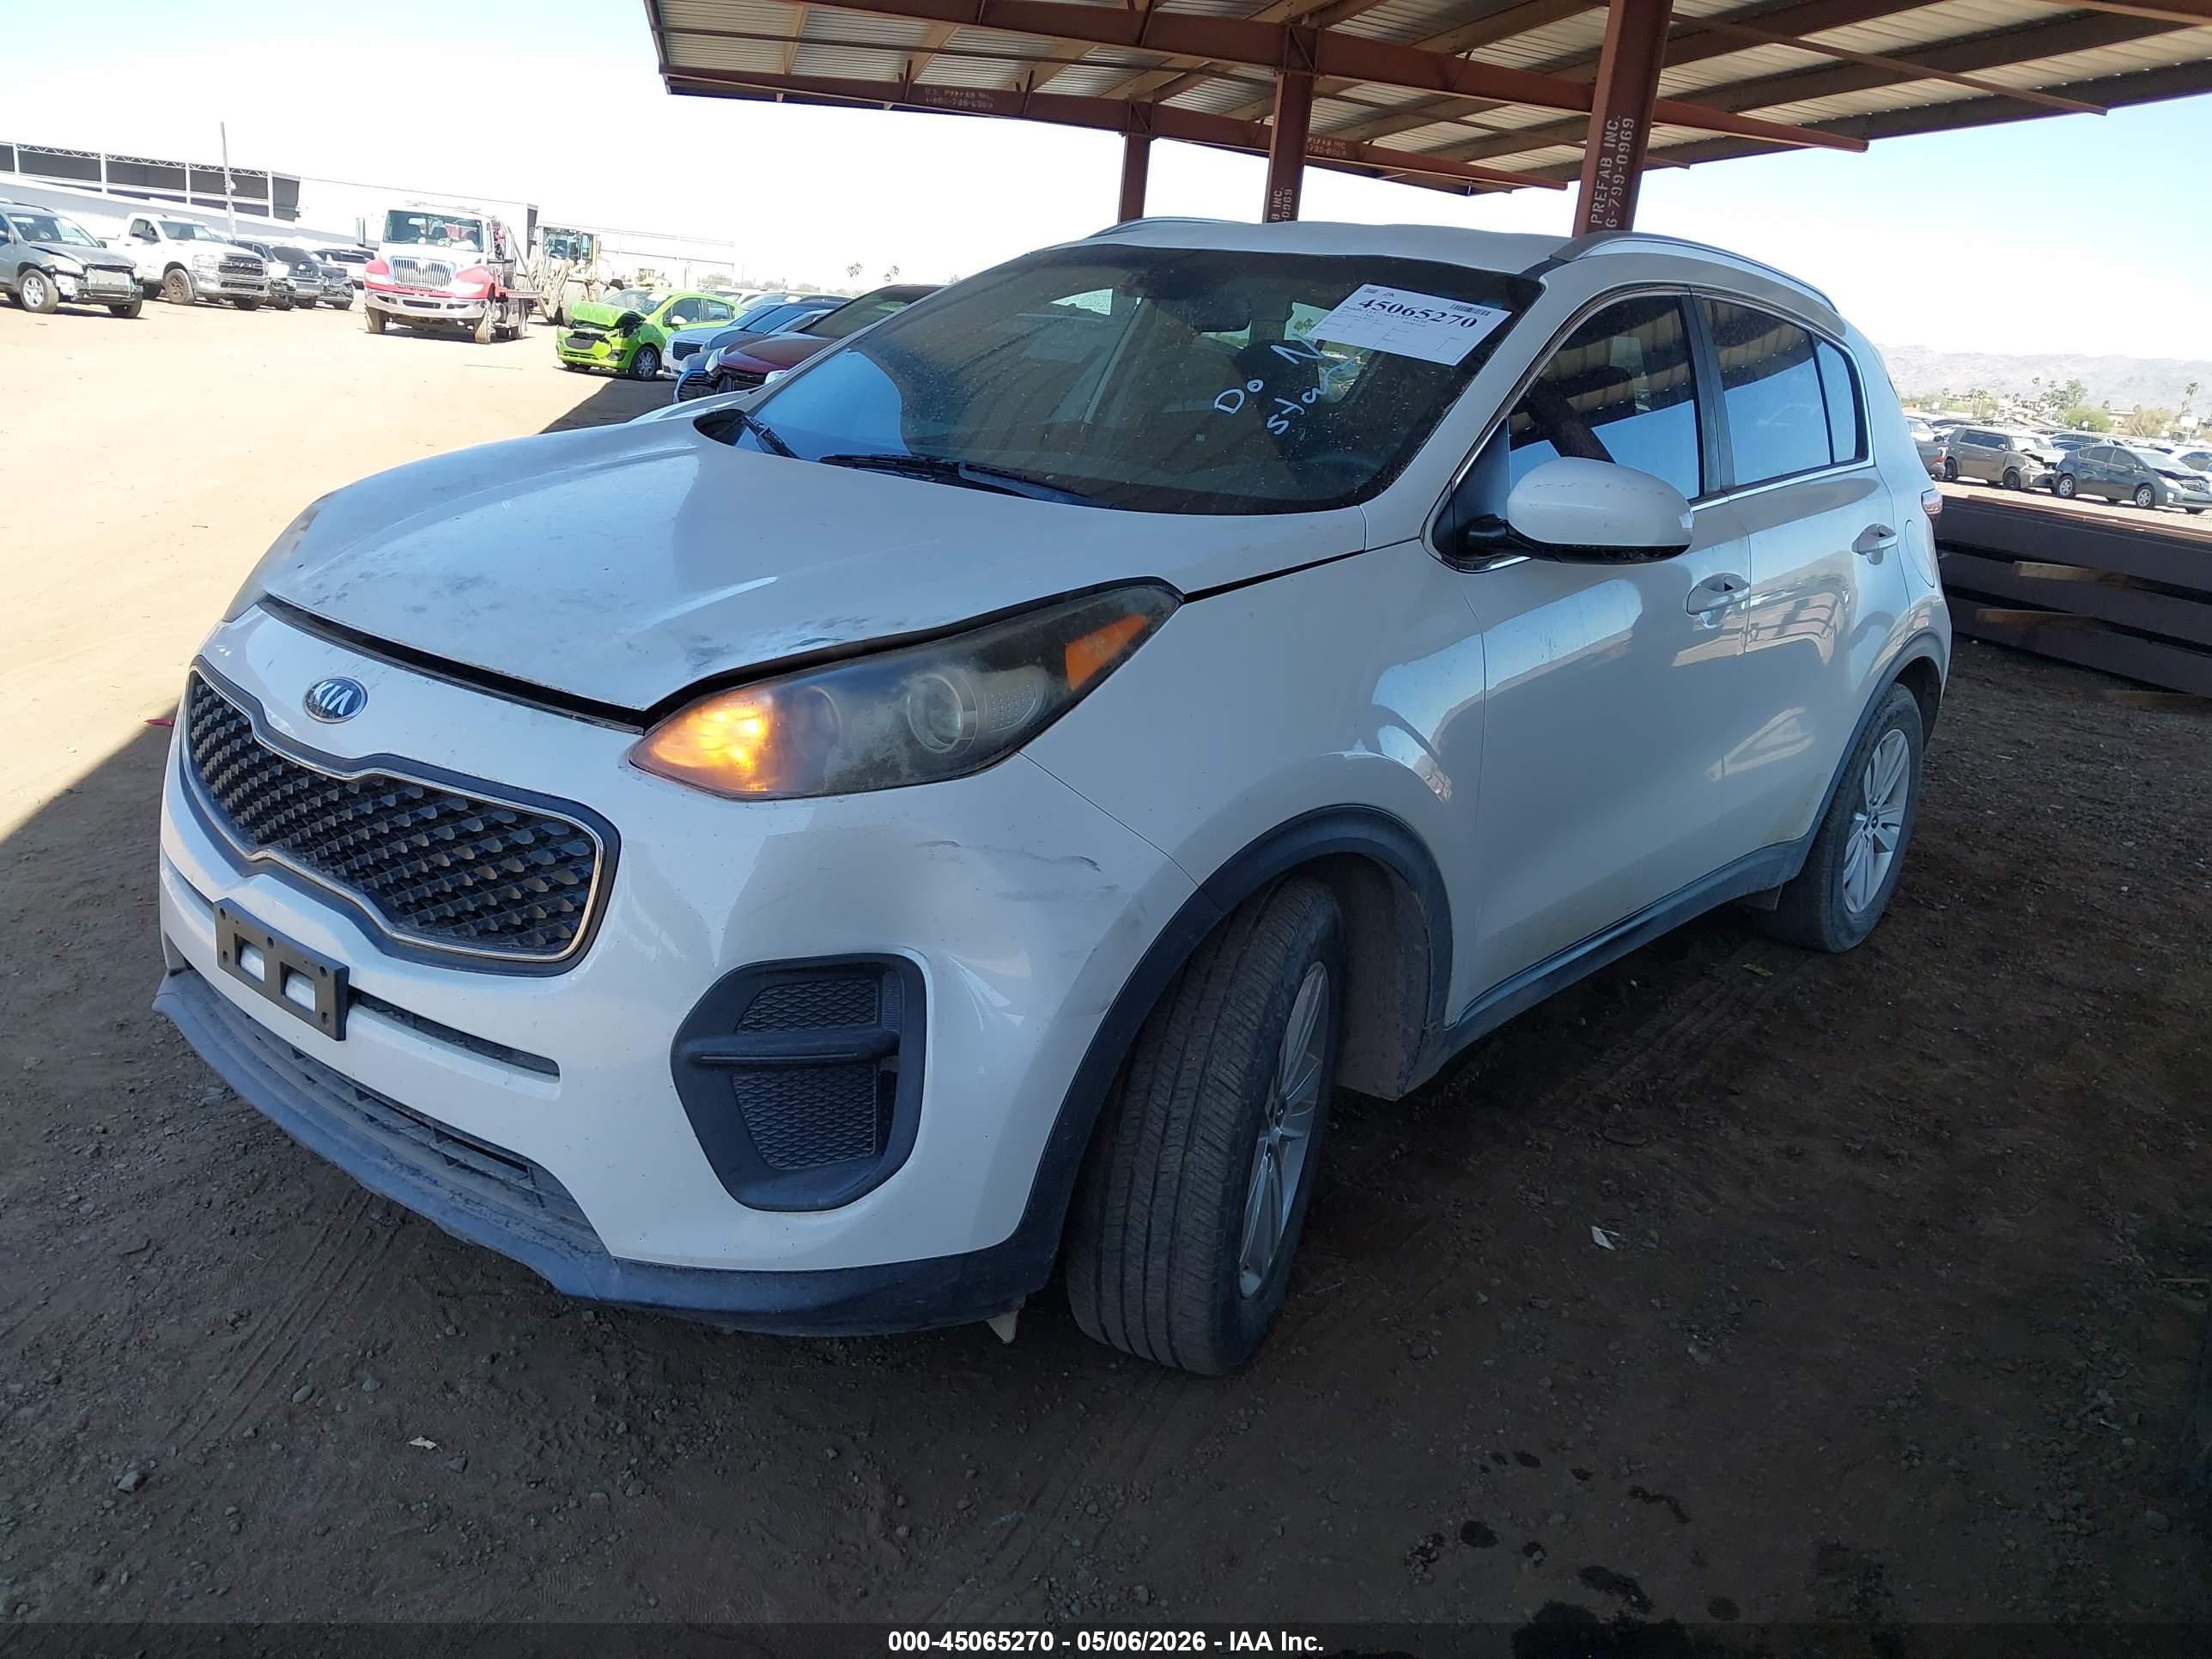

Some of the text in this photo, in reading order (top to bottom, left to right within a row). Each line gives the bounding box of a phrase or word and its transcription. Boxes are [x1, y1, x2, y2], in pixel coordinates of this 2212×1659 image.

[1589, 115, 1620, 224] PREFAB INC.
[1358, 299, 1478, 328] 45065270
[1214, 379, 1264, 414] Do
[312, 682, 354, 715] KIA
